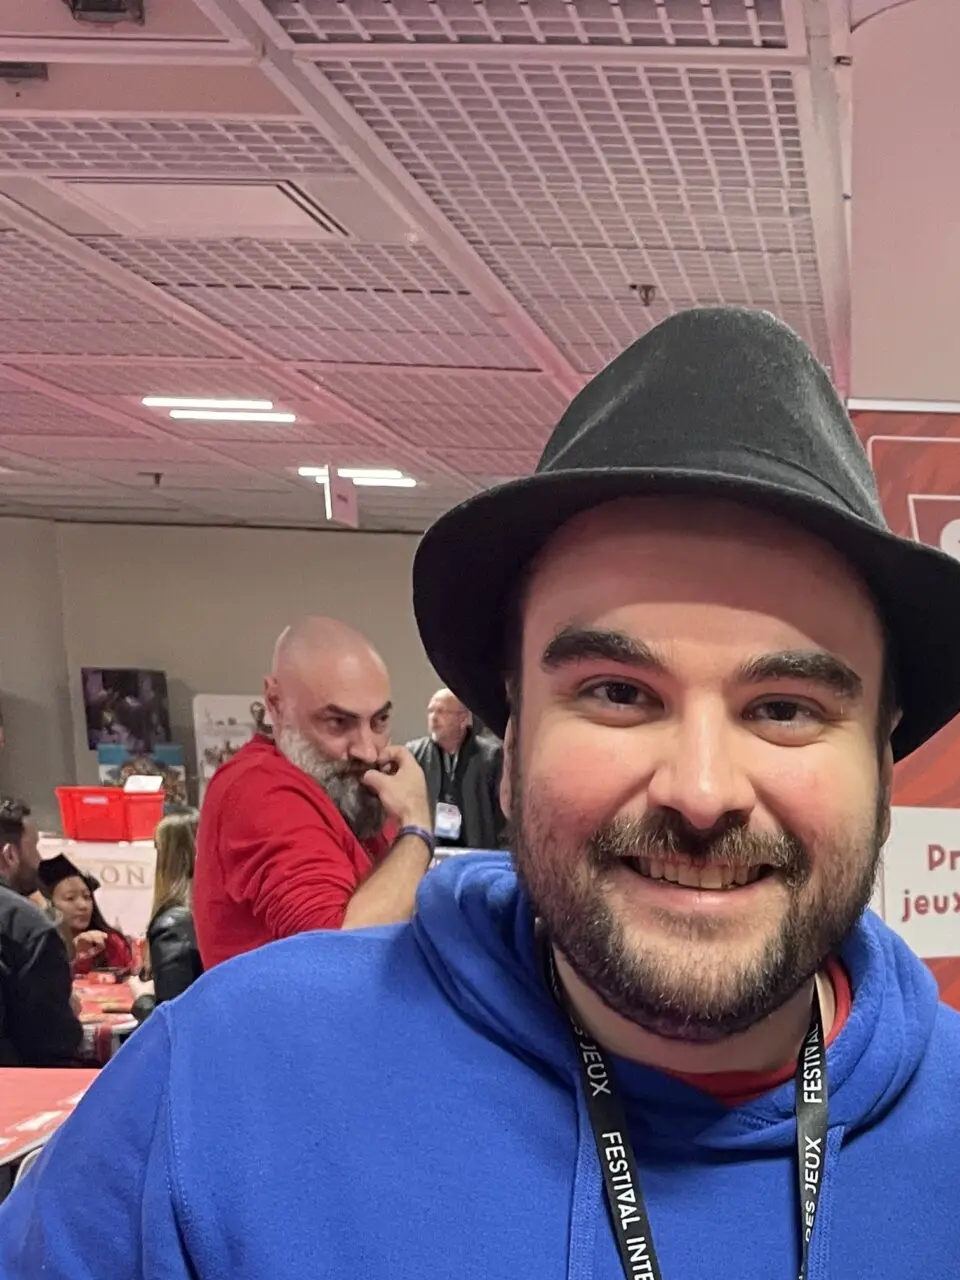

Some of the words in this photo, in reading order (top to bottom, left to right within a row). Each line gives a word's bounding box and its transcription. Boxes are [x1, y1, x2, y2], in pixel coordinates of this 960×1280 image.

[579, 1042, 612, 1097] JEUX
[803, 1023, 823, 1104] FESTIVAL
[601, 1131, 641, 1231] FESTIVAL
[804, 1135, 823, 1194] JEUX
